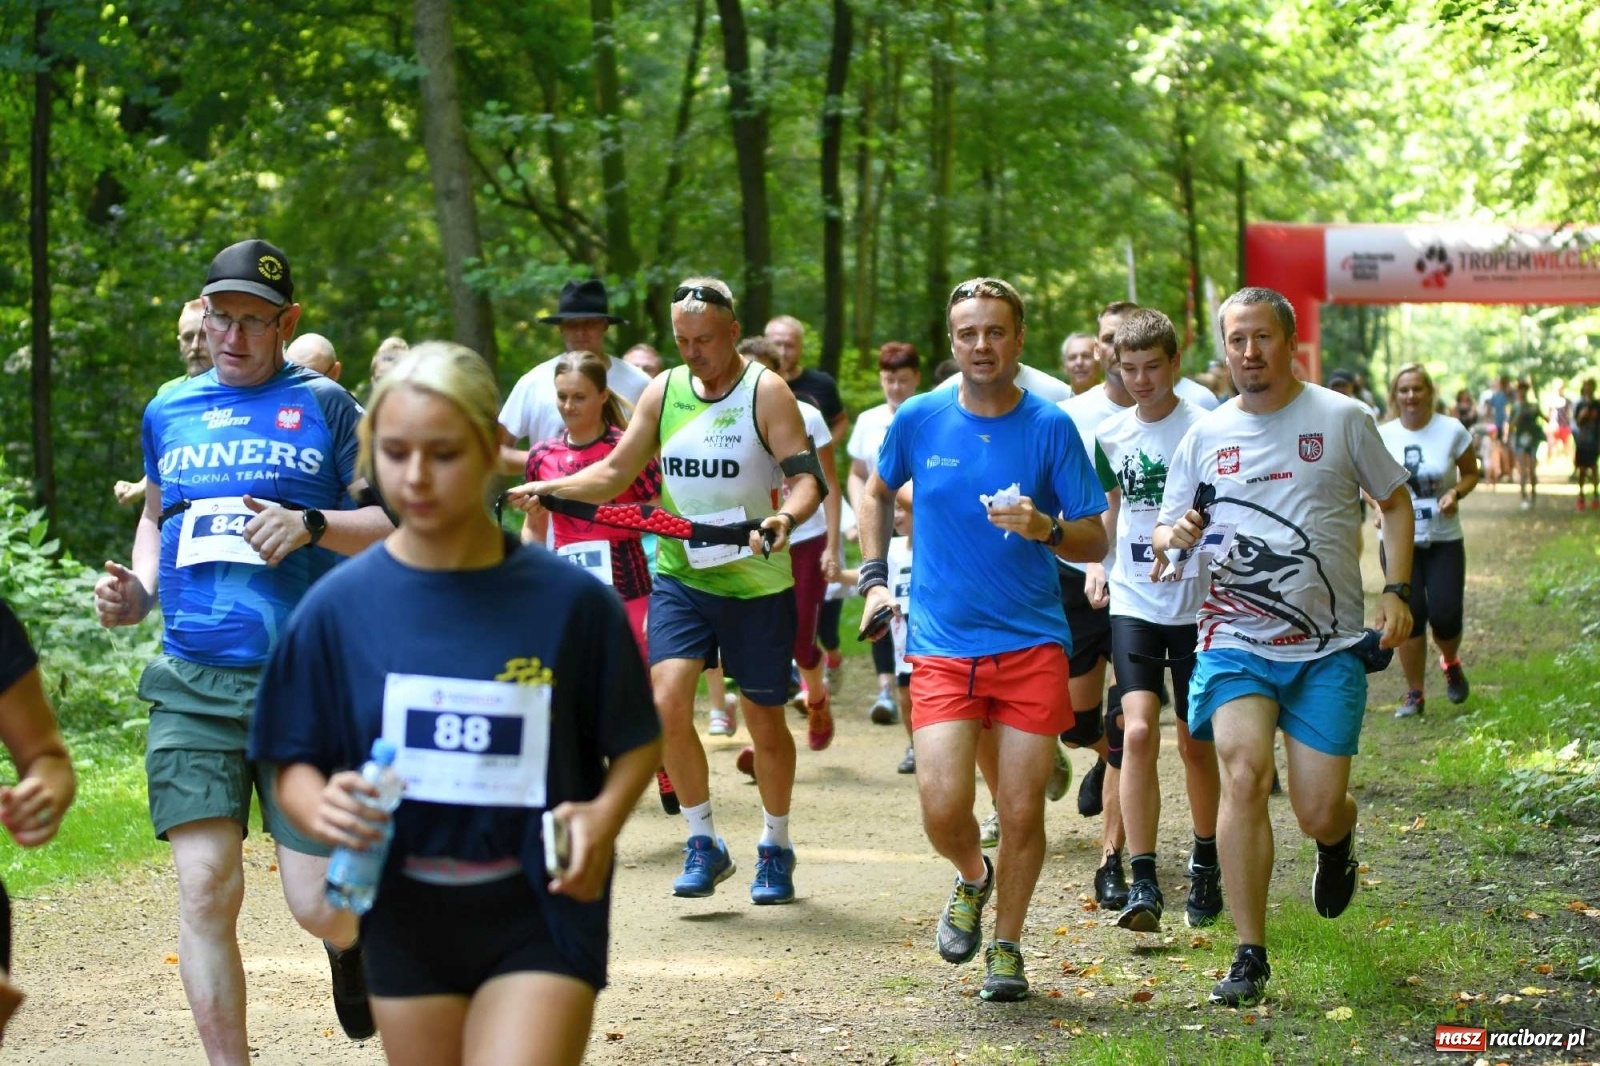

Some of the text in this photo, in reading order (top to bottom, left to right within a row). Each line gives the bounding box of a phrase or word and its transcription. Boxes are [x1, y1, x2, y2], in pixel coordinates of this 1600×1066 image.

[704, 435, 742, 443] AKTYWNI
[236, 470, 280, 481] TEAM
[210, 515, 246, 534] 84
[434, 713, 491, 752] 88
